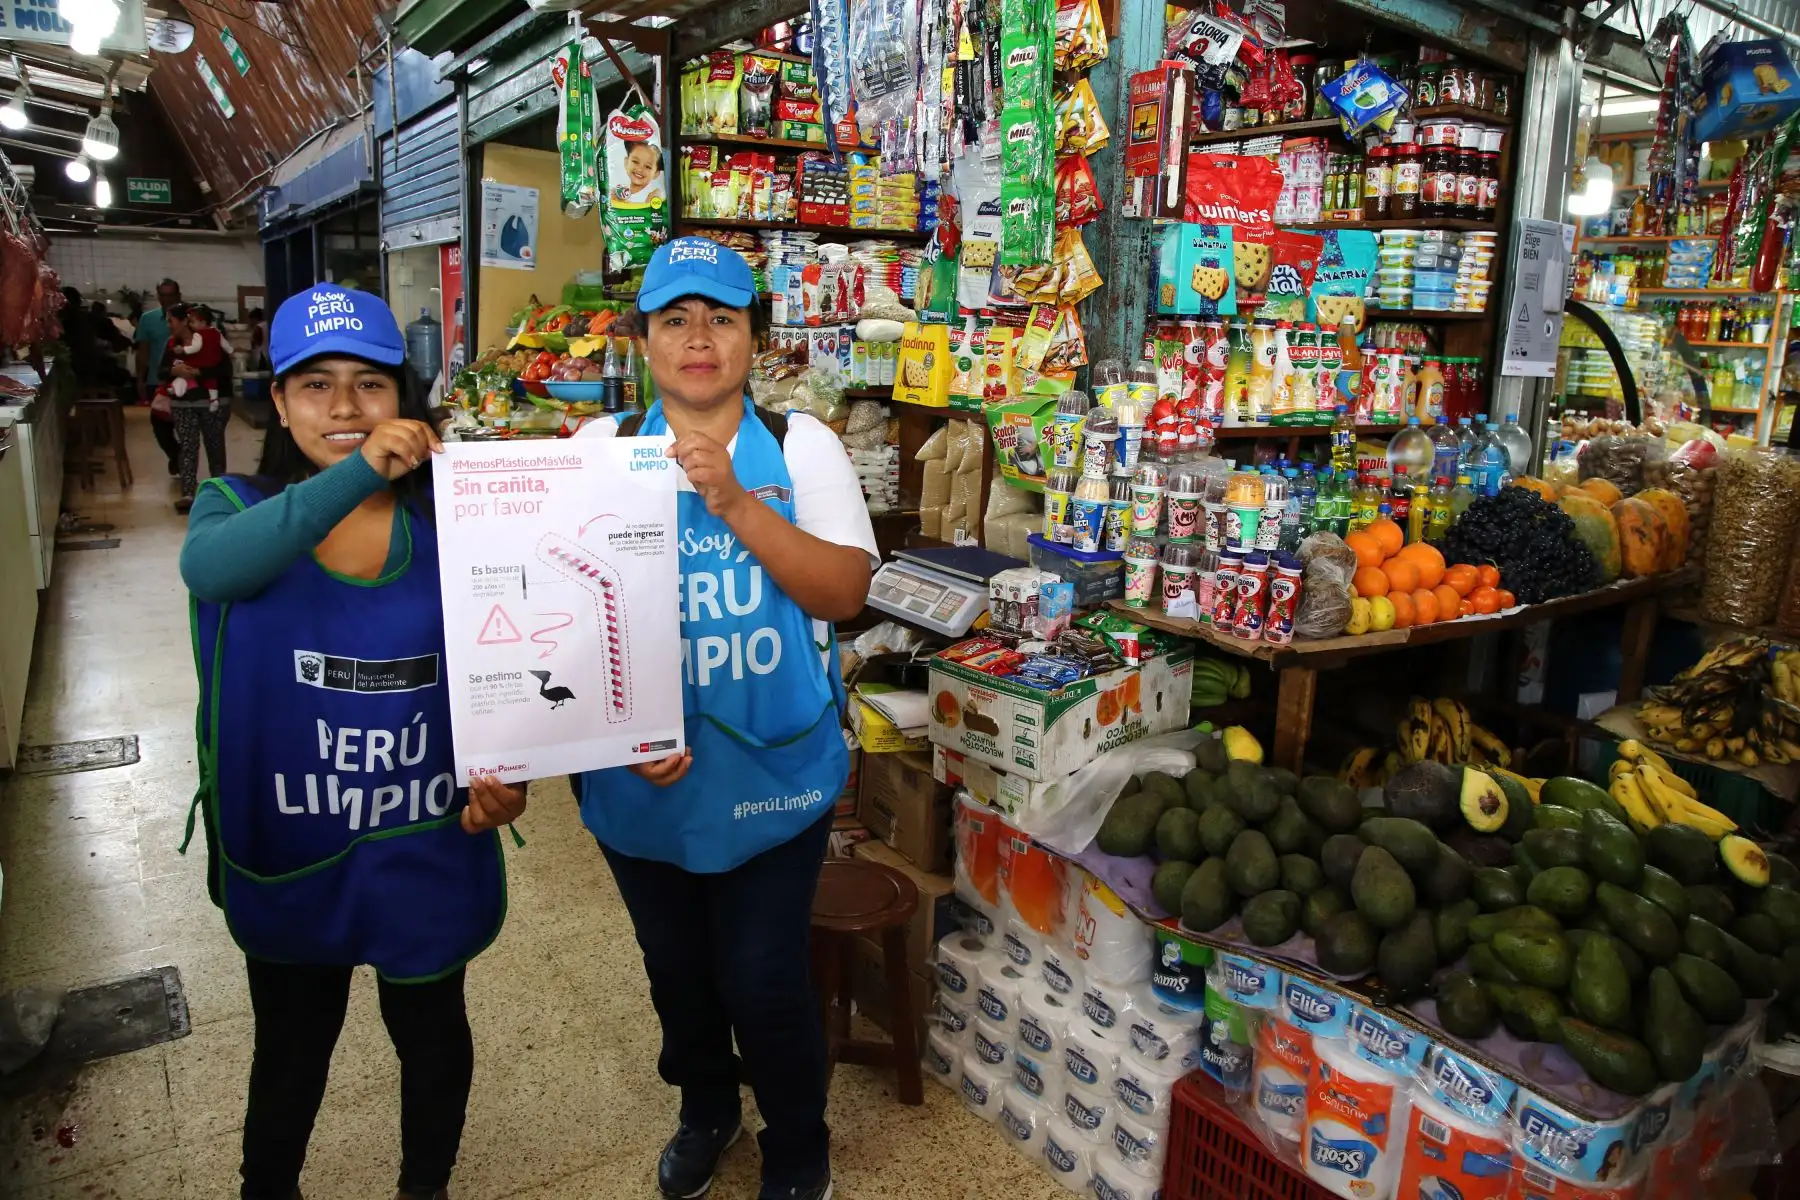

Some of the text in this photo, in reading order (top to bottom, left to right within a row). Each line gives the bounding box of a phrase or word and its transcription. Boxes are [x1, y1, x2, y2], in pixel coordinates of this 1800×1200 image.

[1190, 20, 1231, 48] GLORIA
[1340, 72, 1370, 96] Anchor
[127, 181, 170, 193] SALIDA
[1198, 201, 1271, 224] winter's
[669, 255, 718, 265] LIMPIO
[671, 244, 718, 257] PERÚ
[1523, 248, 1540, 261] BIEN
[308, 298, 355, 319] PERÚ
[304, 316, 364, 337] LIMPIO
[633, 447, 664, 459] PERÚ
[998, 436, 1017, 449] Brite
[451, 454, 582, 471] #MenosPlásticoMásVida
[629, 459, 669, 472] LIMPIO
[453, 475, 550, 496] Sin cañita,
[454, 497, 544, 521] por favor
[608, 530, 665, 541] puede ingresar
[679, 527, 736, 561] Soy
[471, 564, 520, 576] Es basura
[679, 550, 763, 623] RÚ
[369, 679, 407, 688] Ambiente
[468, 671, 522, 684] Se estima
[966, 731, 996, 747] HUAYCO
[1106, 719, 1142, 739] HUAYCO
[960, 735, 1004, 759] MELOCOTÓN
[275, 773, 455, 830] LIMPIO
[733, 787, 823, 820] #PerúLimpio
[1154, 972, 1190, 993] Suave
[1289, 989, 1331, 1017] Elite
[976, 1036, 1000, 1061] Elite
[1358, 1022, 1404, 1054] Elite
[1066, 1054, 1091, 1078] Elite
[1204, 1047, 1239, 1073] Suave
[962, 1078, 984, 1102] Elite
[1438, 1062, 1486, 1100] Elite
[1066, 1098, 1096, 1127] Elite
[1263, 1090, 1302, 1114] Scott
[1319, 1090, 1369, 1120] MULTIUSO
[1115, 1127, 1148, 1157] Elite
[1526, 1115, 1582, 1155] Elite
[1316, 1143, 1364, 1173] Scott
